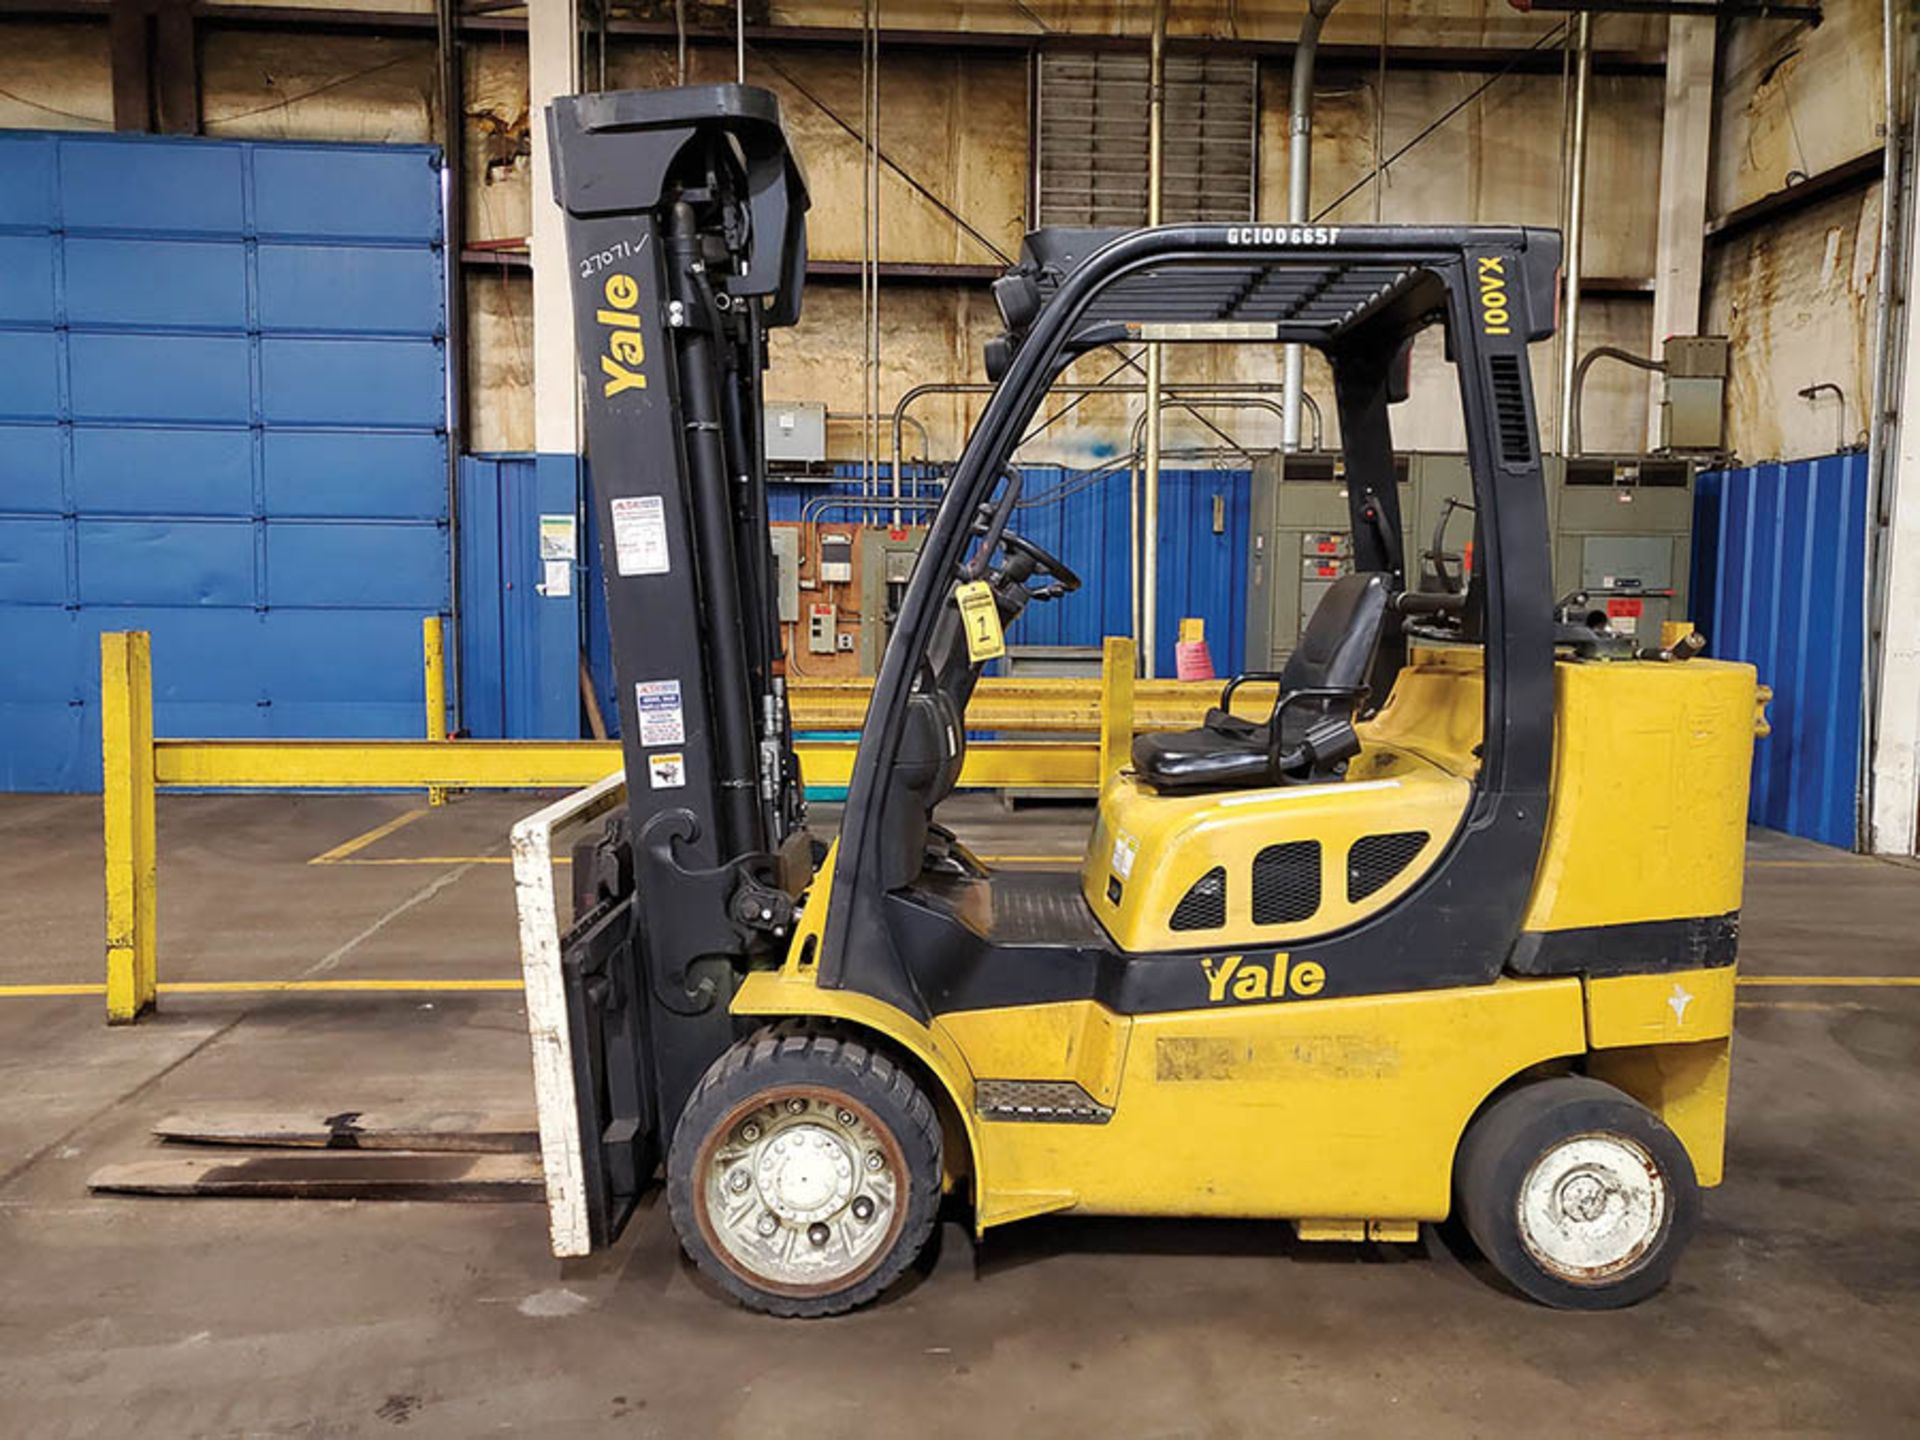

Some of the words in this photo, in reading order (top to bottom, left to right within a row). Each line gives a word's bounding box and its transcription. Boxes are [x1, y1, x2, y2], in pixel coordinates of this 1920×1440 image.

[579, 240, 631, 279] 27071
[1478, 256, 1511, 335] 100VX
[596, 273, 648, 398] Yale
[1200, 952, 1327, 1001] Yale
